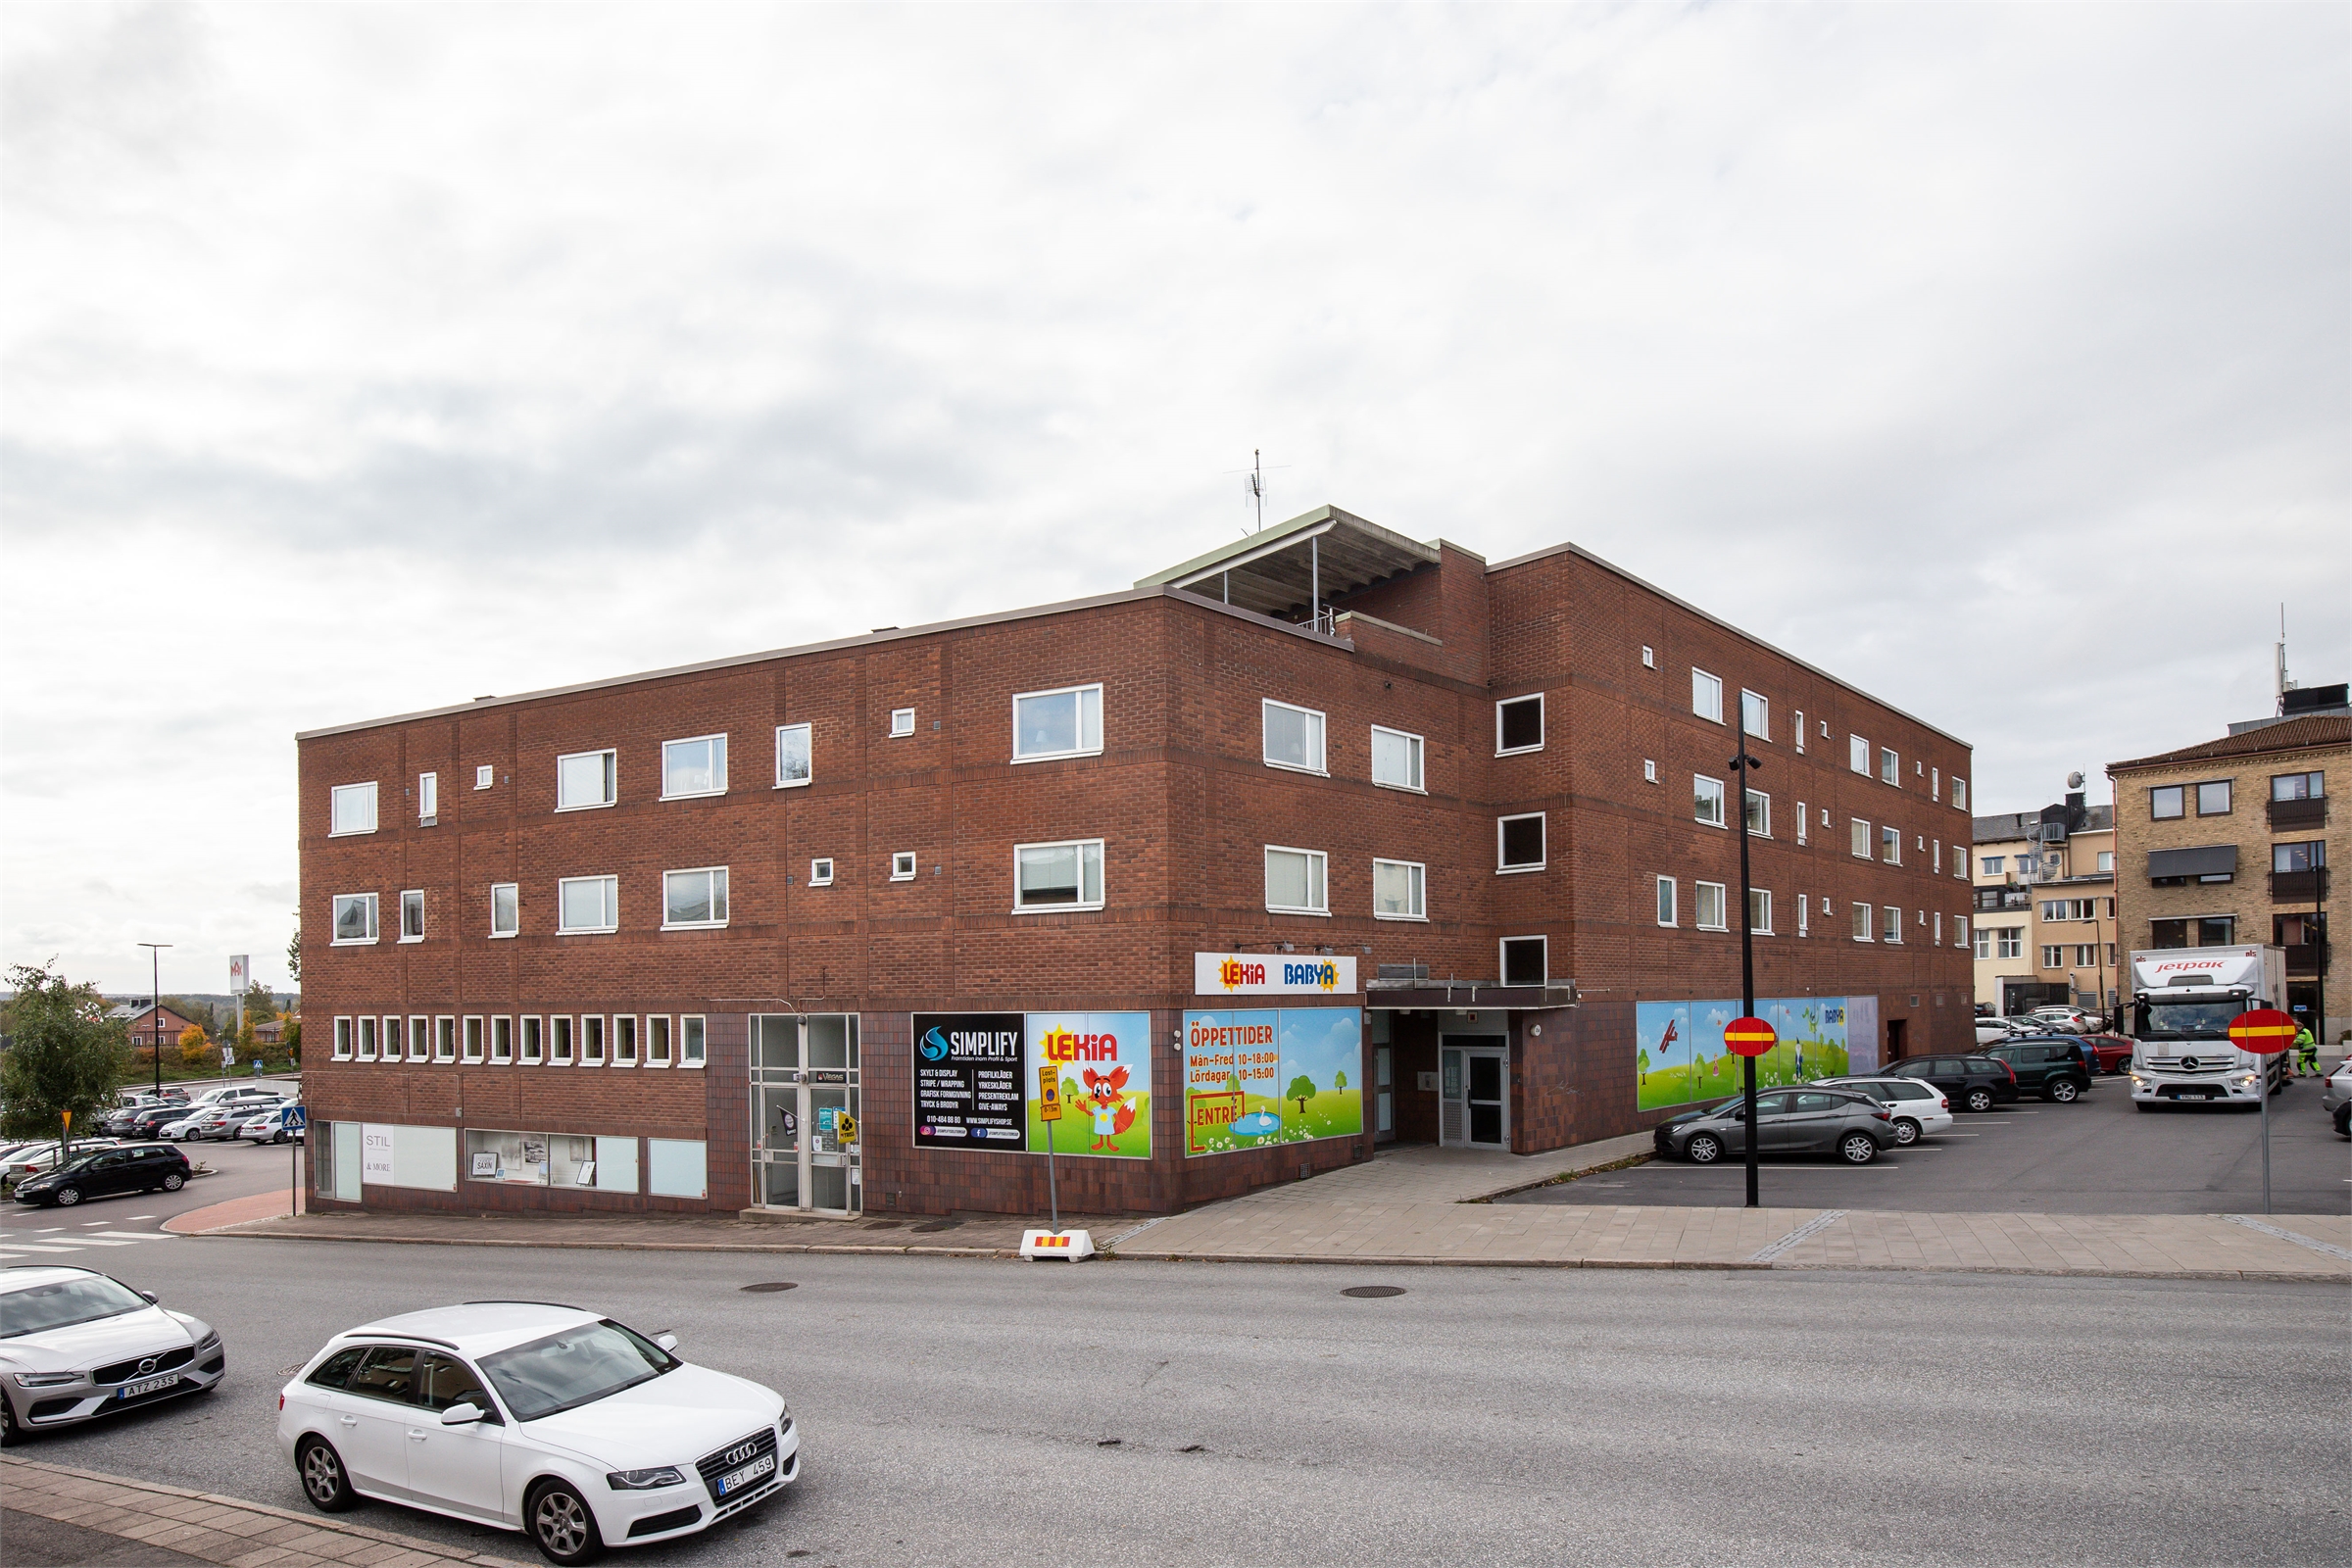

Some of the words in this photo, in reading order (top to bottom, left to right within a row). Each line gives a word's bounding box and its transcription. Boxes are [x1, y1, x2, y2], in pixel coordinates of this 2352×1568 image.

[1284, 963, 1334, 985] BABYA
[2154, 961, 2226, 973] jetpak
[1190, 1021, 1273, 1048] ÖPPETTIDER
[951, 1032, 1018, 1055] SIMPLIFY
[1190, 1053, 1235, 1067] Mån-Fred
[1238, 1052, 1274, 1065] 10-18:00
[1190, 1069, 1231, 1083] Lördagar
[1238, 1066, 1274, 1080] 10-15:00
[978, 1092, 1019, 1101] PRESENTREKLAM
[978, 1102, 1007, 1111] GIVE-AWAYS
[1197, 1099, 1238, 1126] ENTRÉ
[366, 1135, 391, 1147] STIL
[372, 1162, 390, 1172] MORE
[128, 1383, 150, 1396] ATZ
[154, 1376, 174, 1390] 23S
[725, 1470, 745, 1490] BEY
[753, 1457, 772, 1475] 459
